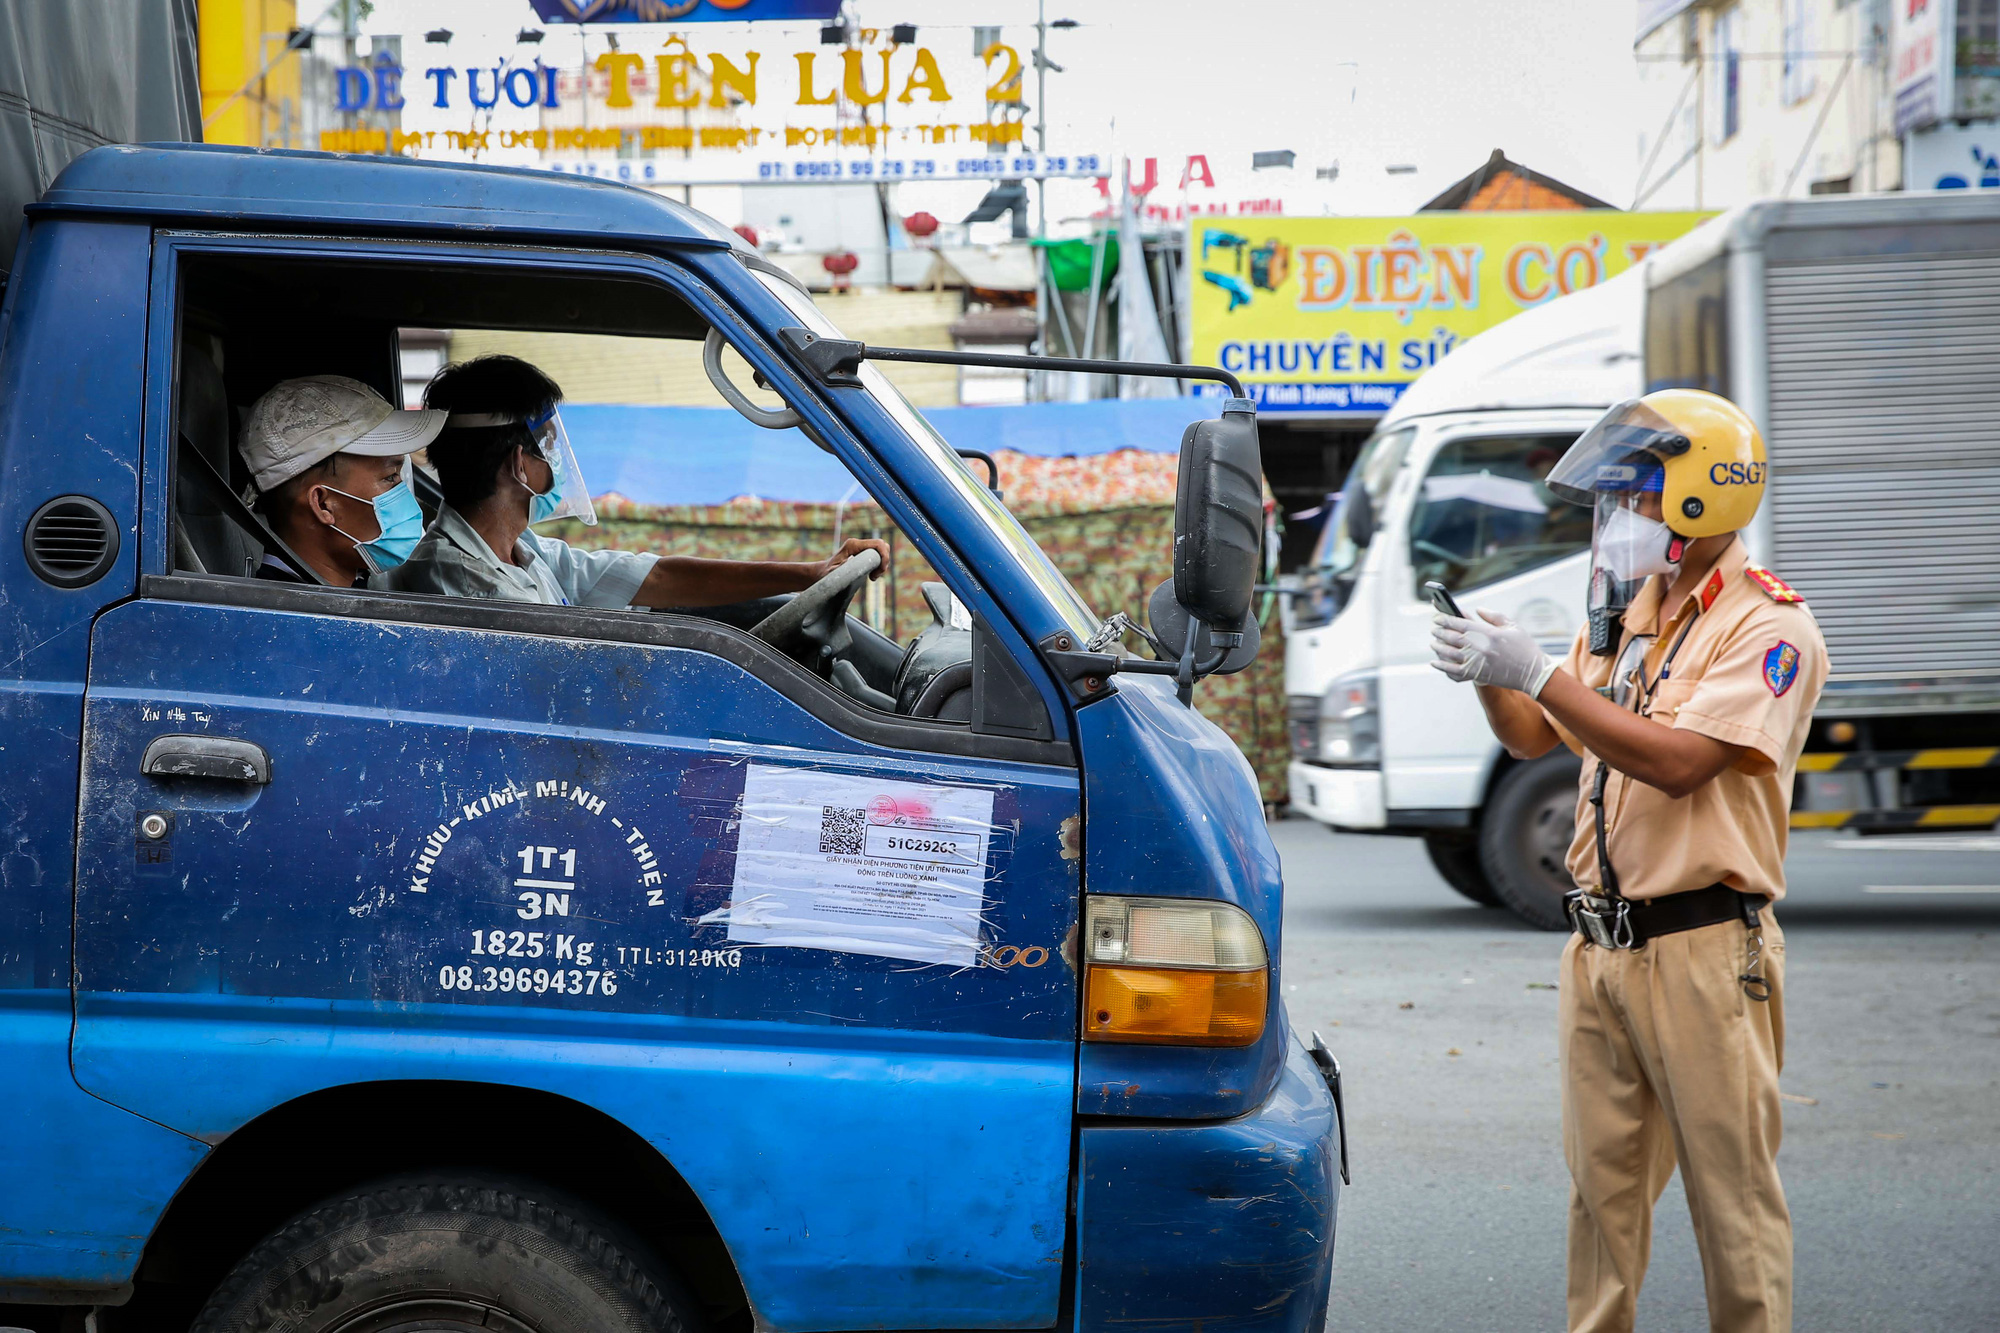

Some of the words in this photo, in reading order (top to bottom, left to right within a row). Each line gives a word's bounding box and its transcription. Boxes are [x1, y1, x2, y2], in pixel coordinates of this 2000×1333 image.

[333, 50, 405, 111] DÊ
[595, 35, 760, 108] TÊN
[983, 42, 1023, 103] 2
[1299, 232, 1478, 322] ĐIỆN
[1506, 233, 1603, 304] CƠ
[1220, 331, 1384, 372] CHUYÊN
[517, 845, 577, 877] 1T1
[517, 891, 570, 921] 3N
[470, 930, 545, 959] 1825
[555, 934, 595, 966] Kg
[439, 965, 618, 996] 08.39694376
